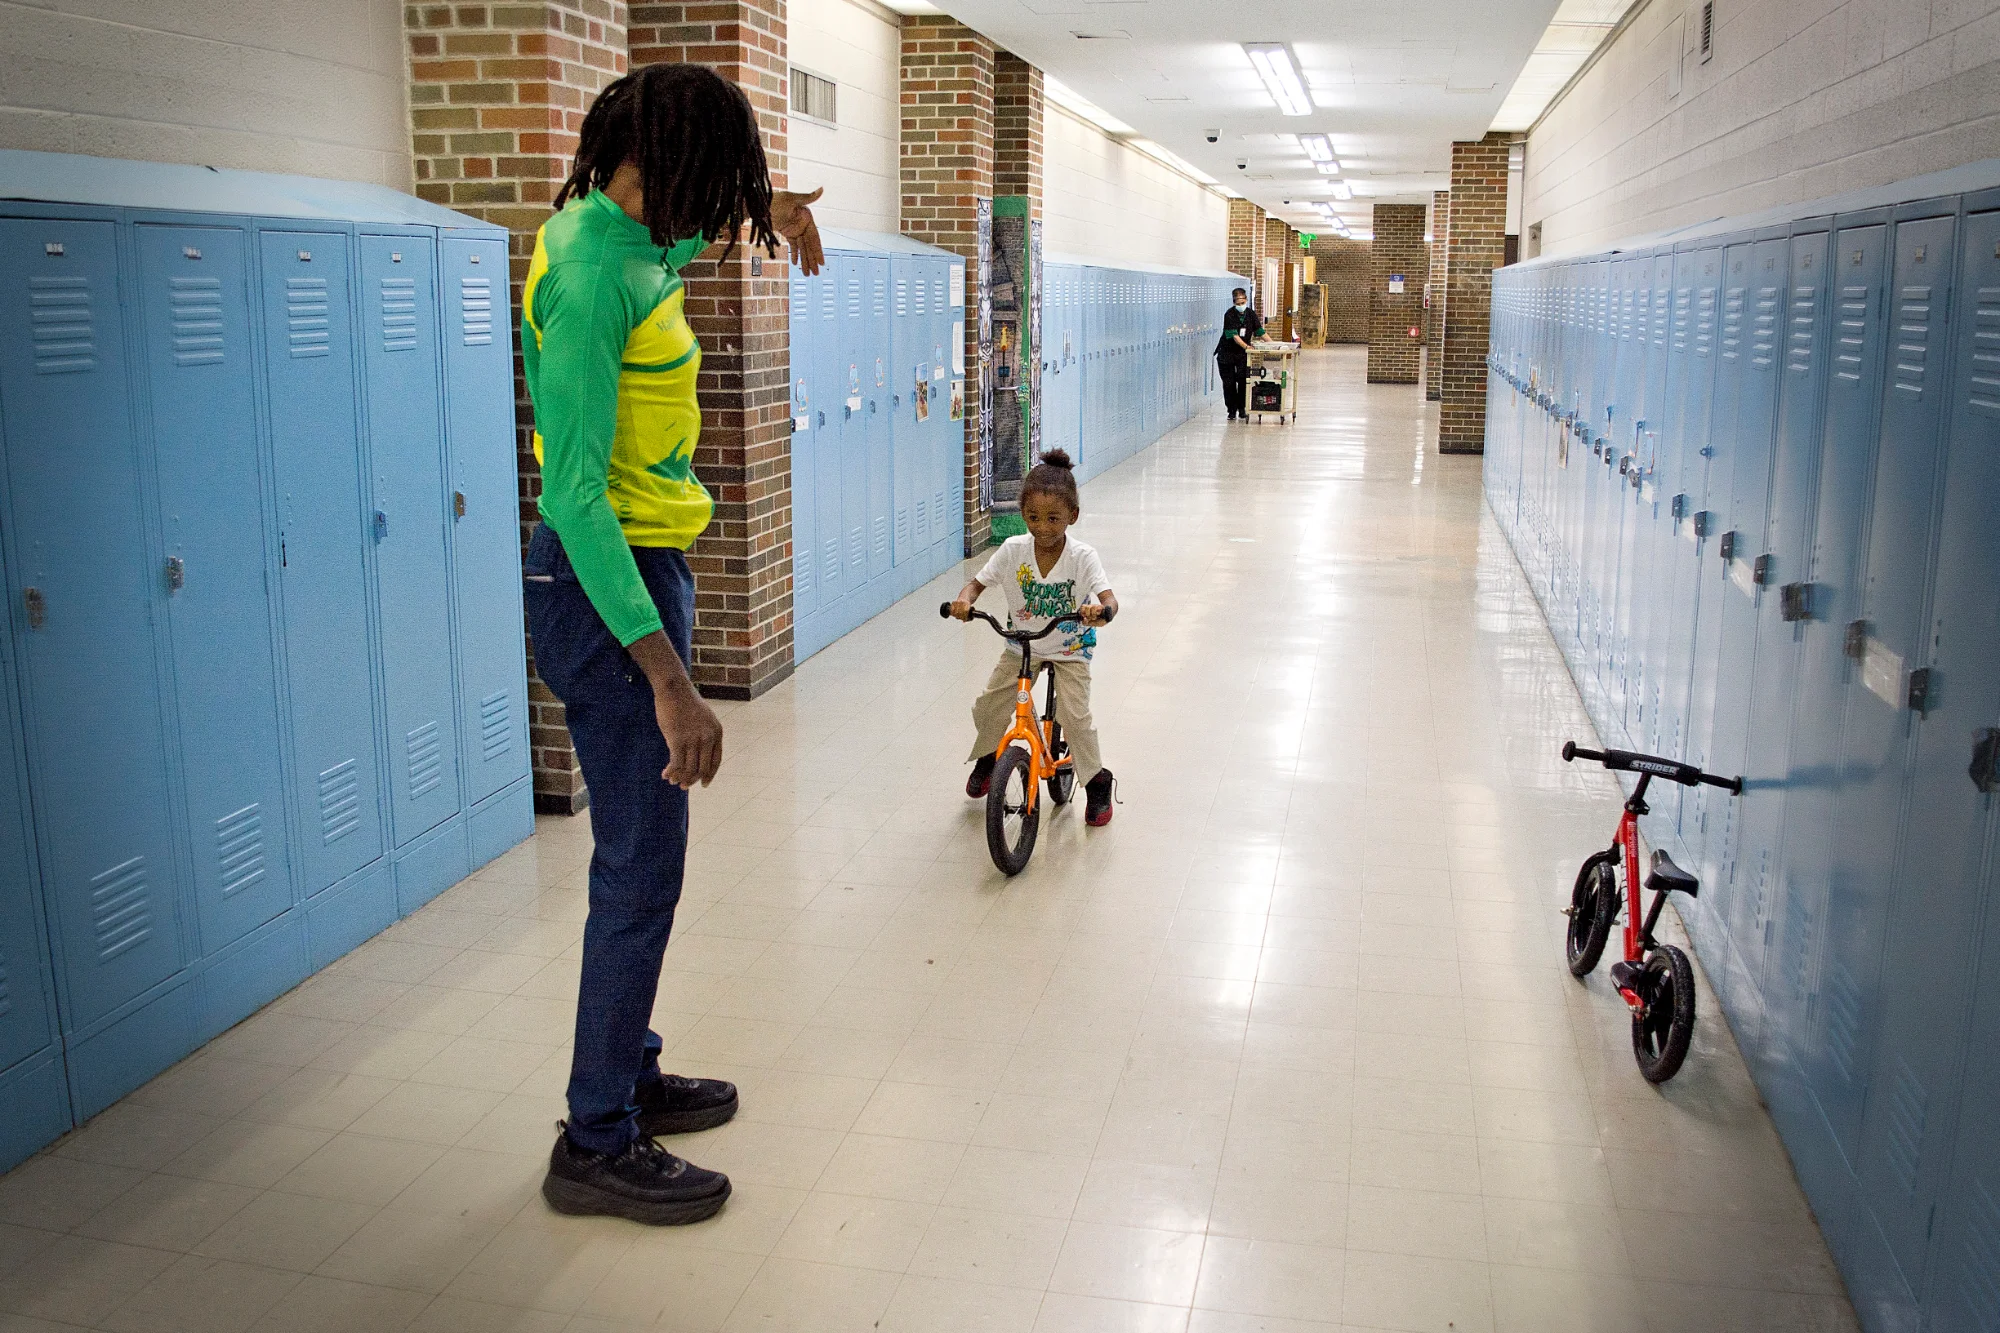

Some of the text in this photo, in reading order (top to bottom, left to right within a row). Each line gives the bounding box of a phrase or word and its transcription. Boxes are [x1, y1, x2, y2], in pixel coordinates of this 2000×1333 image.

[1022, 579, 1075, 600] LOONEY
[1024, 594, 1073, 618] TUNES
[1630, 760, 1678, 776] STRIDER
